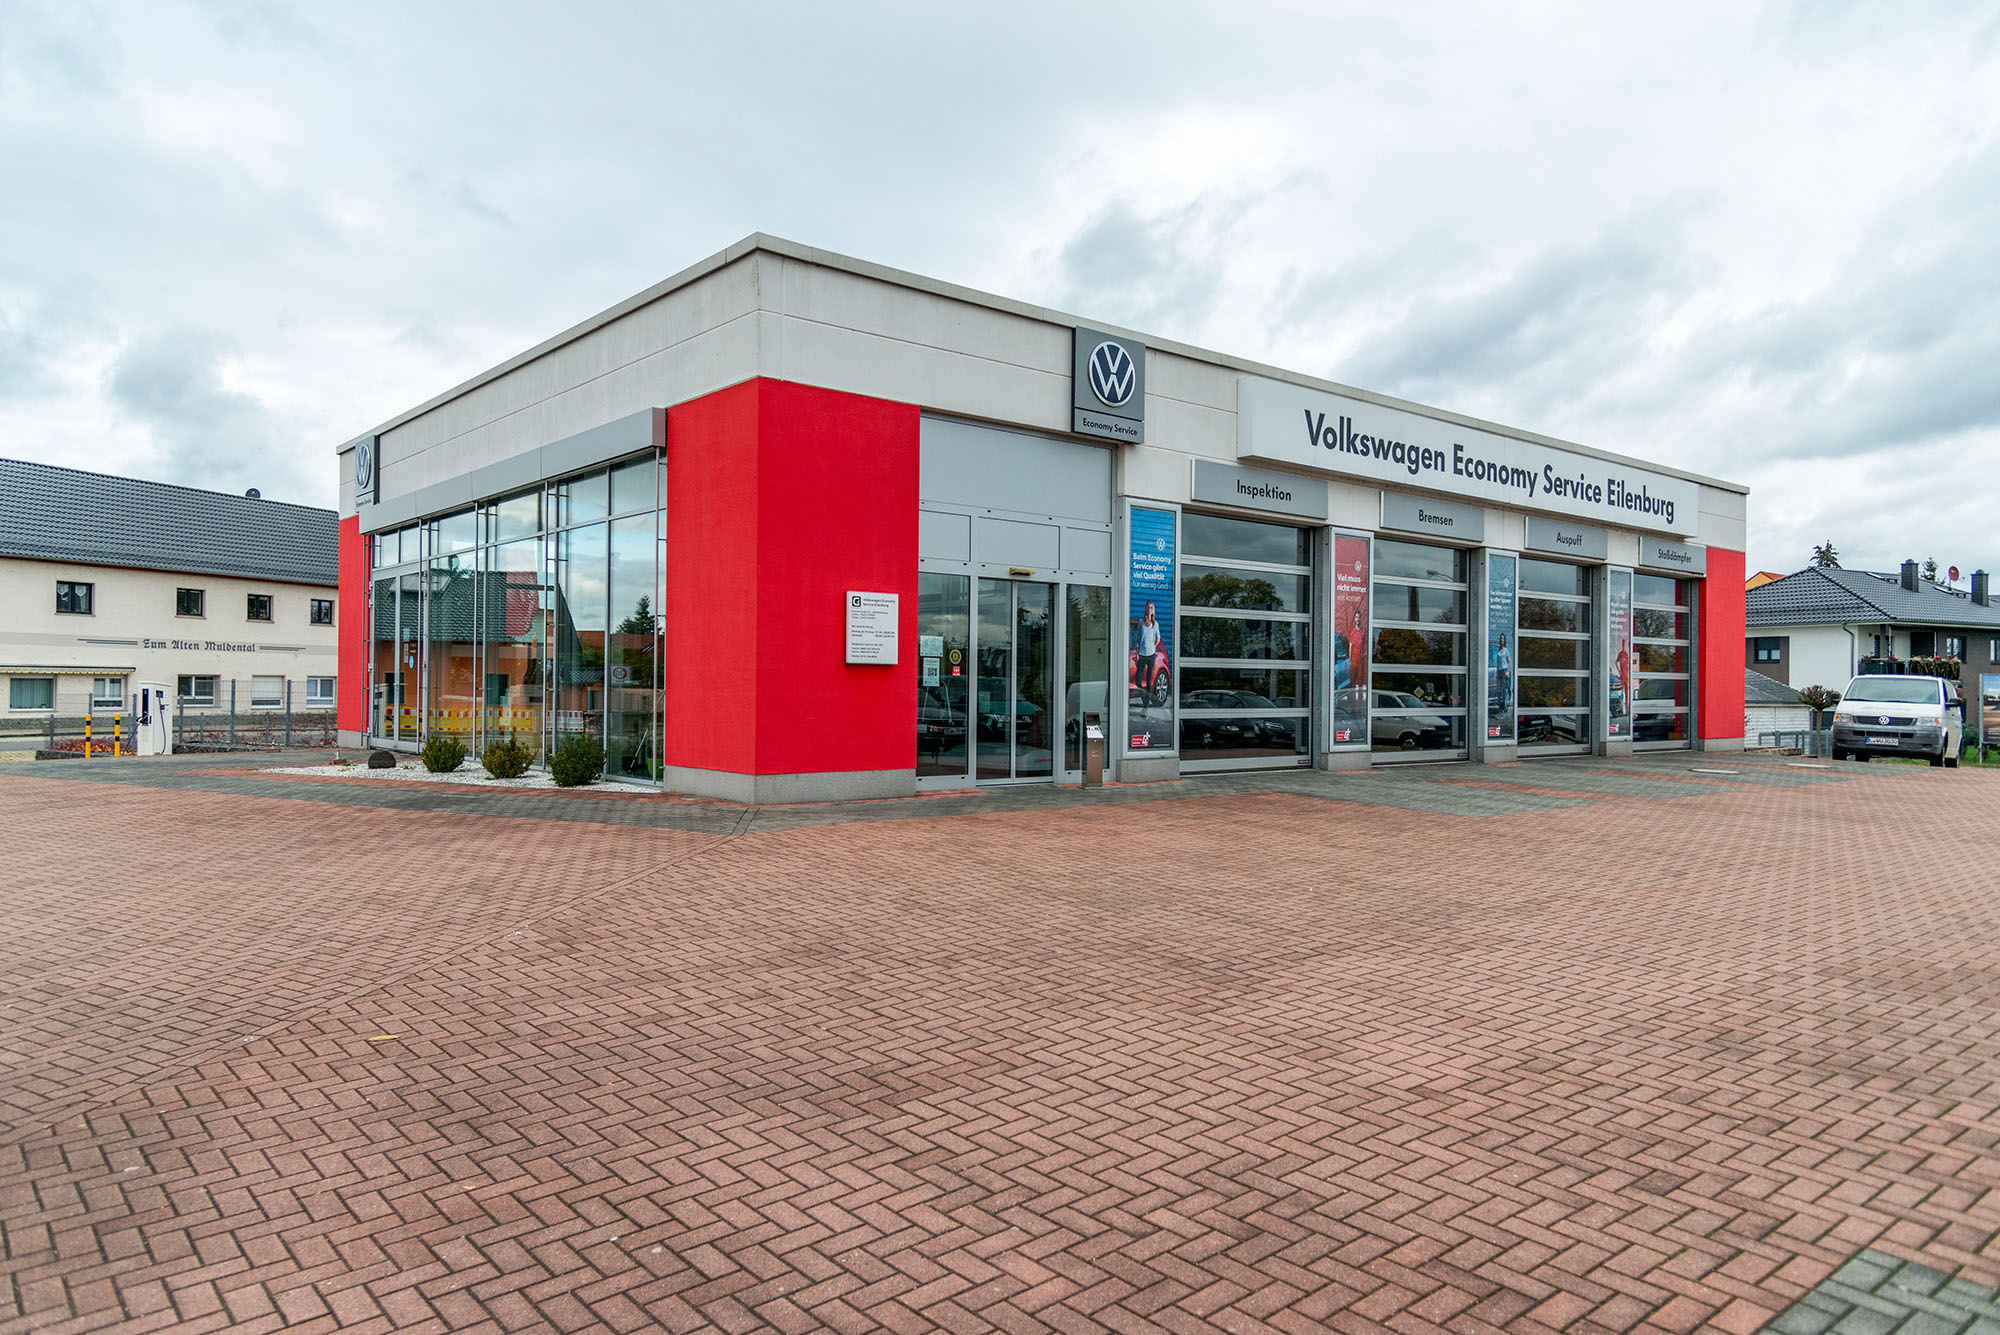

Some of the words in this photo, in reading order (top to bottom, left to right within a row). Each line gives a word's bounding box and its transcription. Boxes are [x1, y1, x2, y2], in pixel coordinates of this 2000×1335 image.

[1082, 417, 1113, 433] Economy
[1114, 423, 1138, 436] Service
[1304, 409, 1446, 475] Volkswagen
[1453, 443, 1538, 498] Economy
[1543, 464, 1602, 504] Service
[1607, 478, 1675, 525] Eilenburg
[1237, 479, 1291, 501] Inspektion
[1418, 509, 1454, 526] Bremsen
[1556, 532, 1583, 548] Auspuff
[1132, 552, 1147, 561] Beim
[1147, 554, 1171, 565] Economy
[1658, 548, 1692, 564] Stoßdämpfer
[1132, 561, 1152, 571] Service
[1132, 571, 1143, 579] viel
[1143, 572, 1165, 581] Qualität
[1336, 573, 1347, 581] Viel
[1336, 584, 1350, 592] nicht
[1350, 584, 1367, 593] immer
[142, 638, 167, 649] Zum
[171, 639, 200, 650] Alten
[204, 641, 256, 653] Muldental
